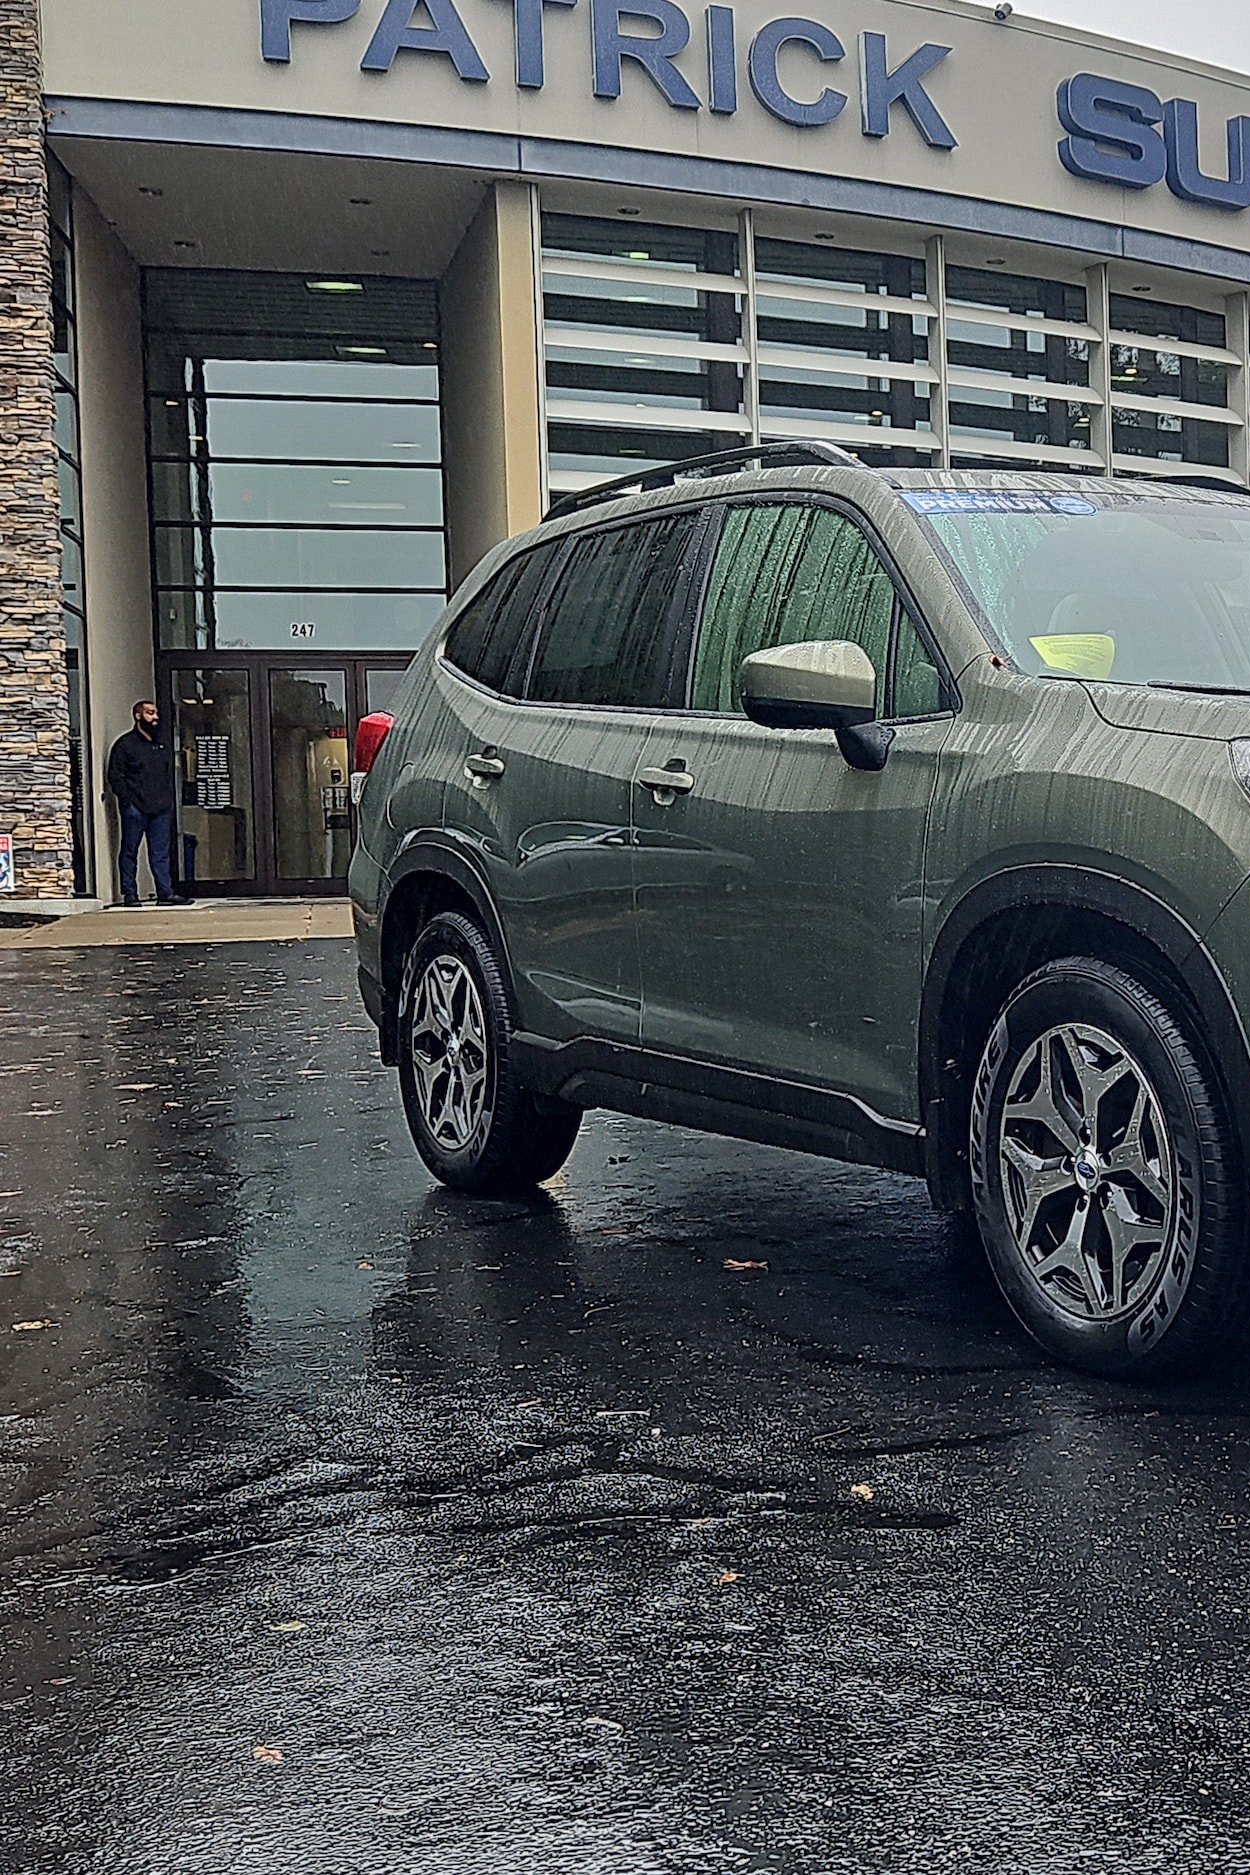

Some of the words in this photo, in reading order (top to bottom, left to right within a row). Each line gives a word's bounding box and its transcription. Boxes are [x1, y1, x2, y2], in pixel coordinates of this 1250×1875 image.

[259, 0, 960, 149] PATRICK
[917, 499, 1052, 511] PREMIUM
[291, 623, 315, 637] 247
